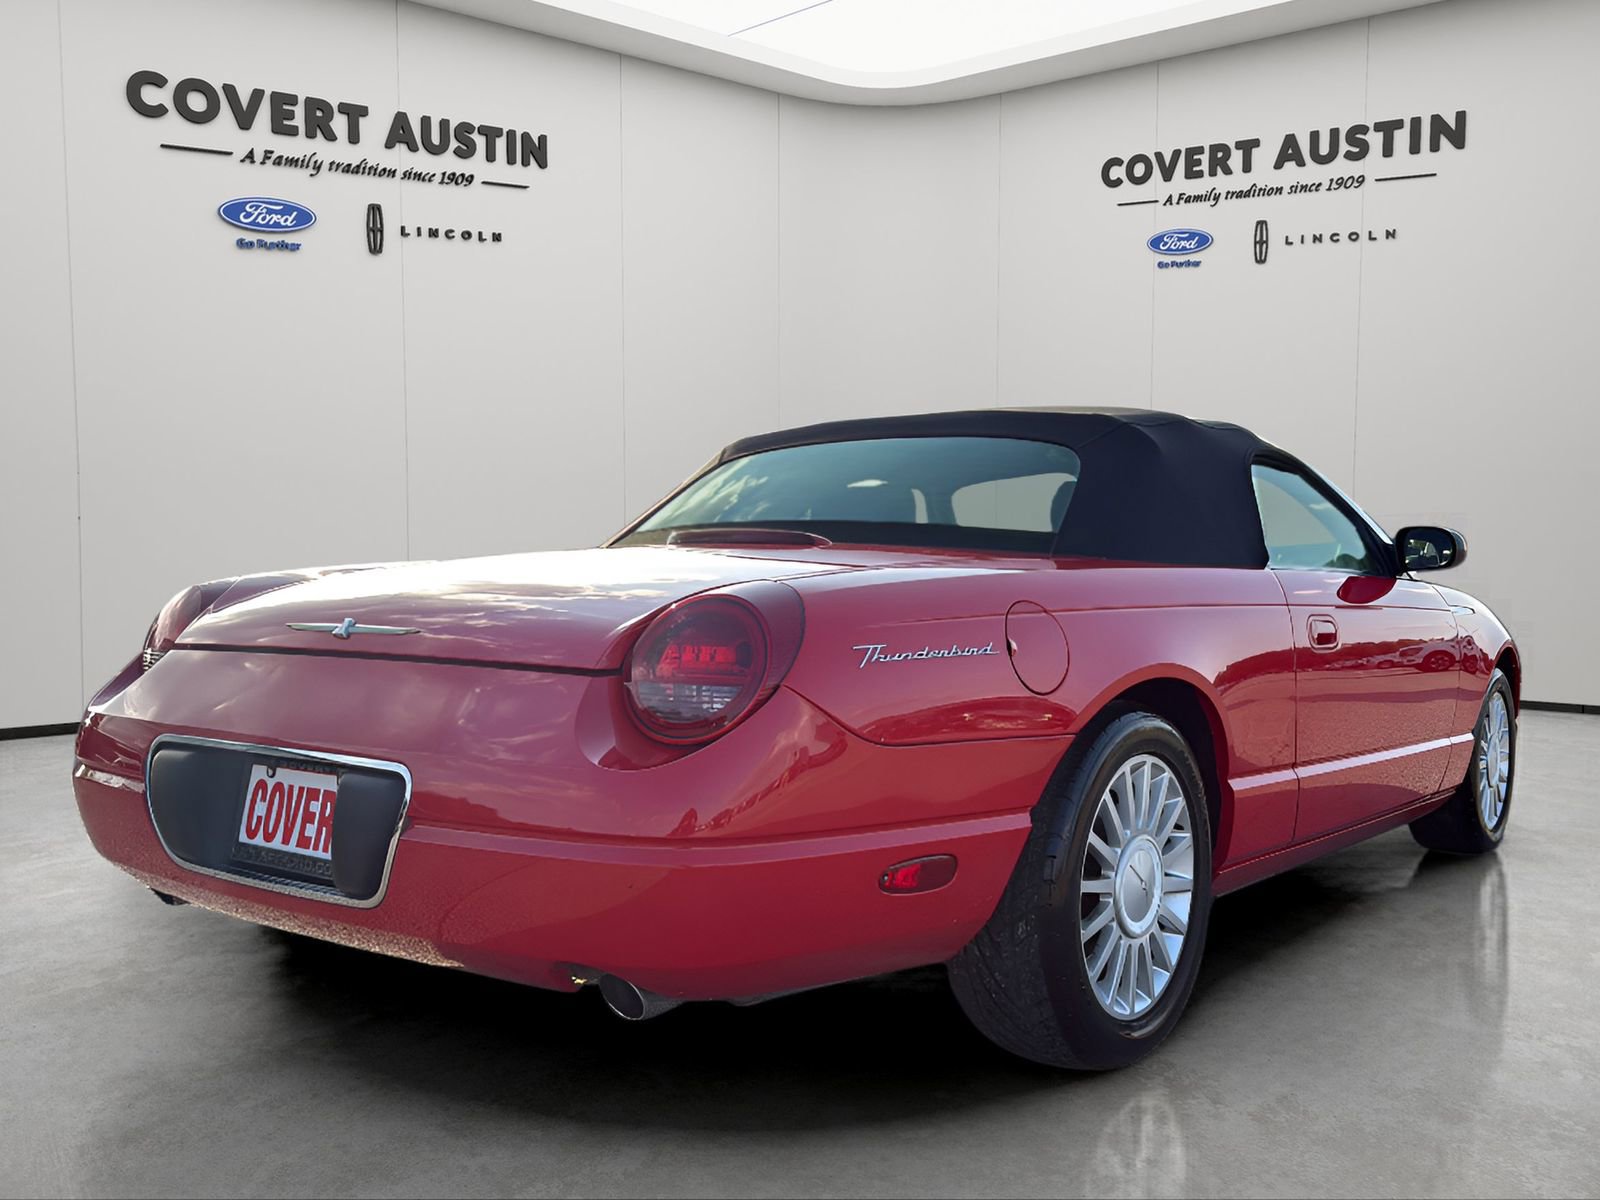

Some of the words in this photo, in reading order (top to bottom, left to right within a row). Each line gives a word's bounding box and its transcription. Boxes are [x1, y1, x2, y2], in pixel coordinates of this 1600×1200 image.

[126, 70, 369, 145] COVERT
[384, 110, 548, 170] AUSTIN
[1100, 138, 1261, 189] COVERT
[1273, 110, 1467, 170] AUSTIN
[239, 147, 257, 164] A
[259, 149, 324, 177] Family
[327, 158, 398, 180] tradition
[400, 166, 437, 184] since
[438, 170, 475, 188] 1909
[1162, 193, 1175, 207] A
[1175, 187, 1222, 208] Family
[1224, 182, 1284, 201] tradition
[1287, 180, 1323, 195] since
[1325, 174, 1366, 192] 1909
[239, 201, 298, 227] Ford
[400, 225, 503, 243] LINCOLN
[1159, 232, 1200, 250] Ford
[1284, 228, 1397, 246] LINCOLN
[852, 641, 1000, 669] Thunderbird
[245, 778, 336, 854] COVER
